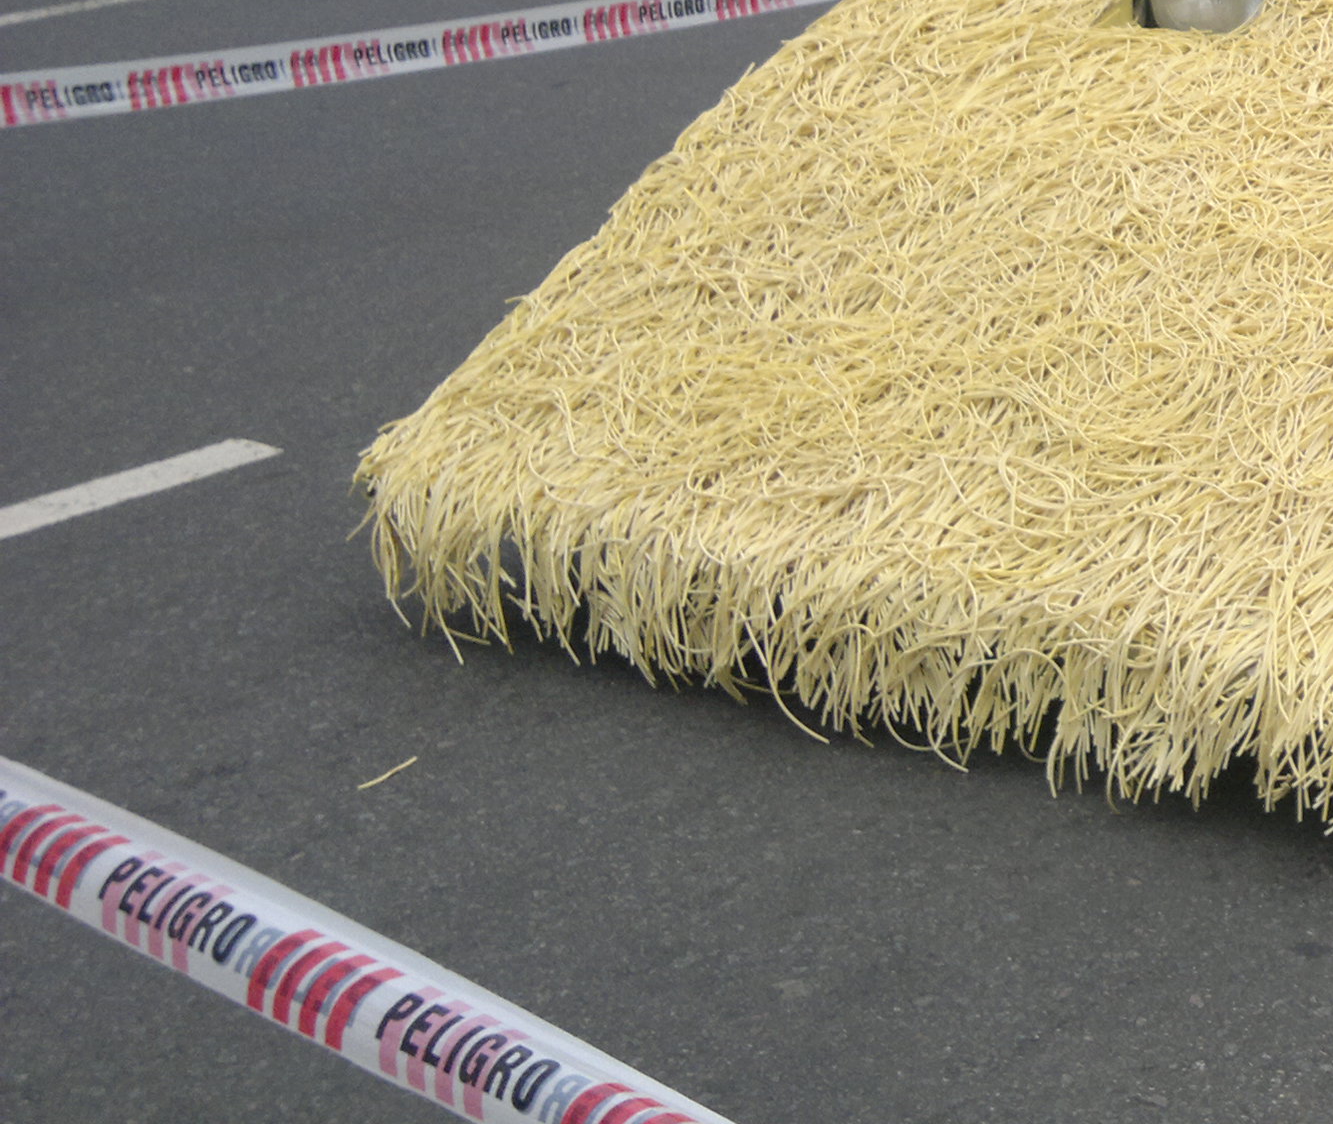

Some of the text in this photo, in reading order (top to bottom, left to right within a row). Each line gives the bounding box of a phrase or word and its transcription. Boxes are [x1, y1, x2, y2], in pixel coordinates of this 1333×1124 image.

[26, 81, 114, 110] PELIGRO
[195, 58, 278, 87] PELIGRO
[353, 38, 431, 68] PELIGRO
[501, 16, 573, 44] PELIGRO
[98, 856, 561, 1113] PELIGRO PELIGRO
